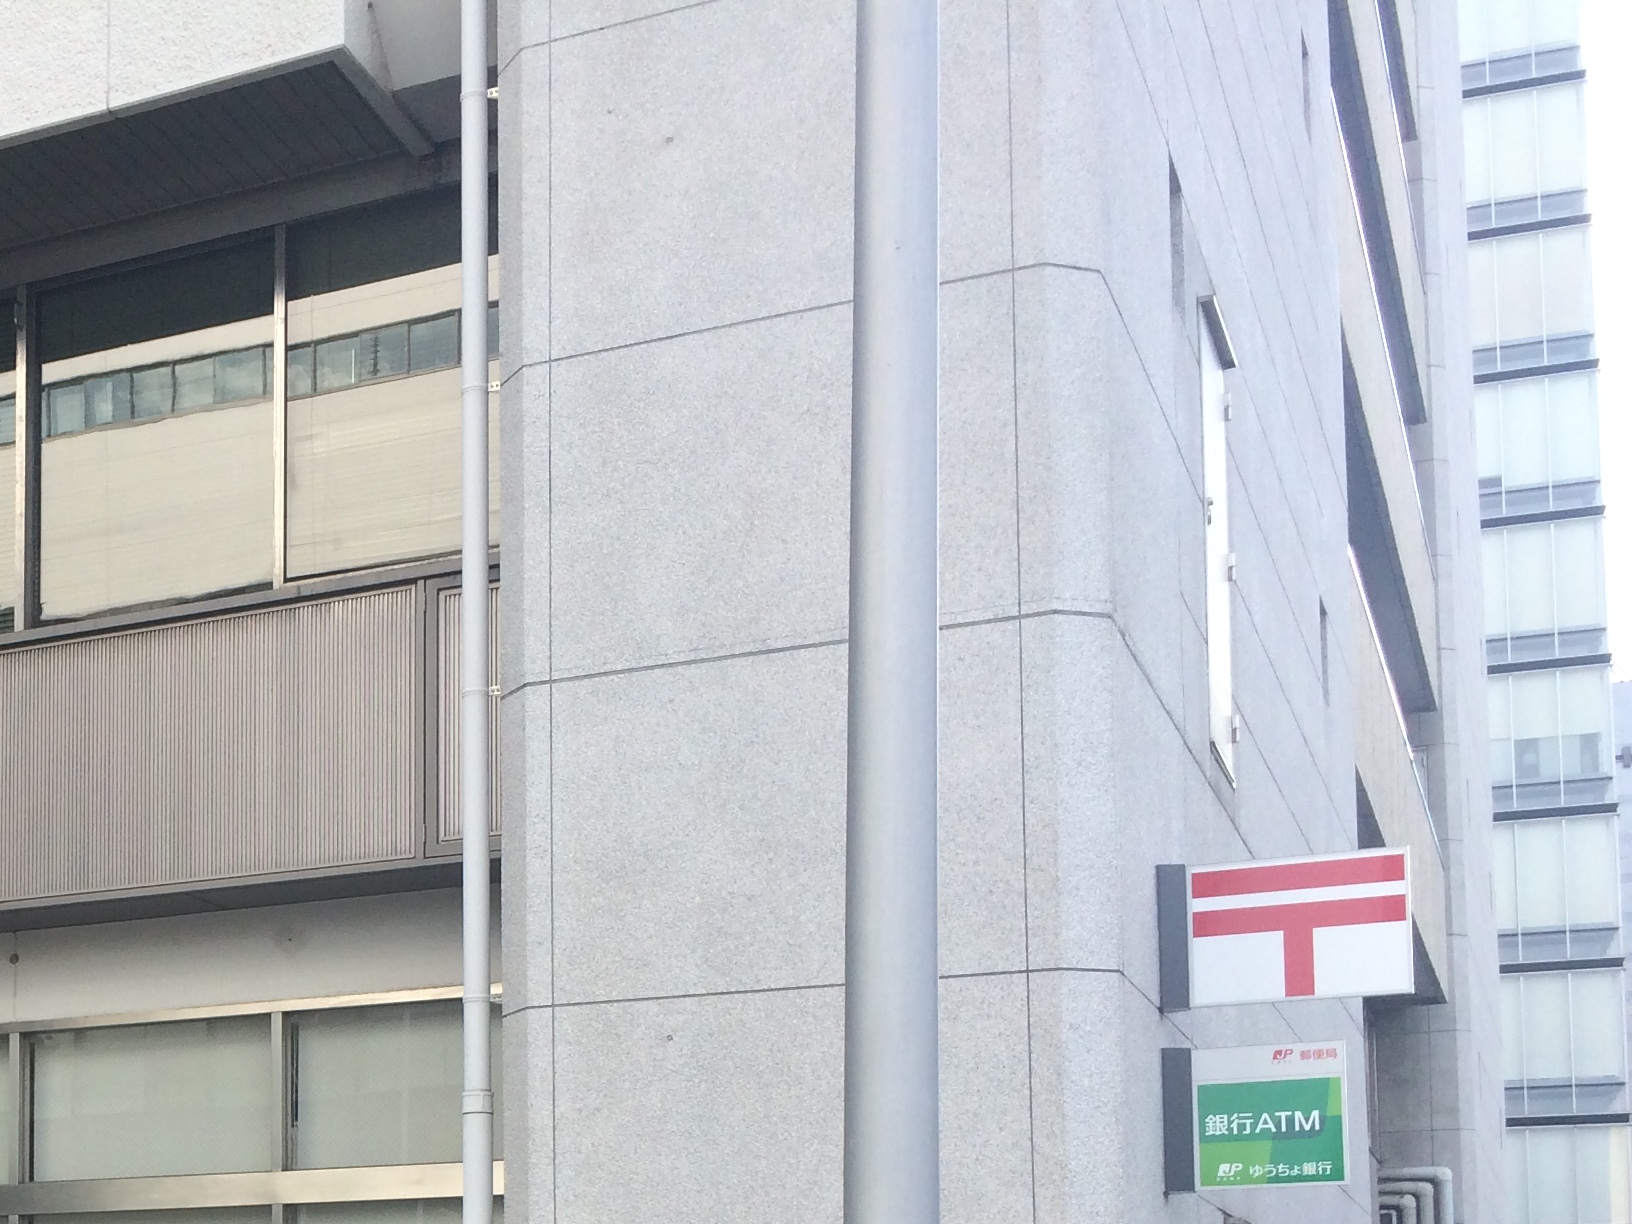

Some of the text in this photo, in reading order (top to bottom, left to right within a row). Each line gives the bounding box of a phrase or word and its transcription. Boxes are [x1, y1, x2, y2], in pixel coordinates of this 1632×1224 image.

[1299, 1048, 1338, 1061] 郵便局
[1204, 1109, 1320, 1136] 銀行ATM
[1249, 1160, 1333, 1178] ゆうちょ銀行
